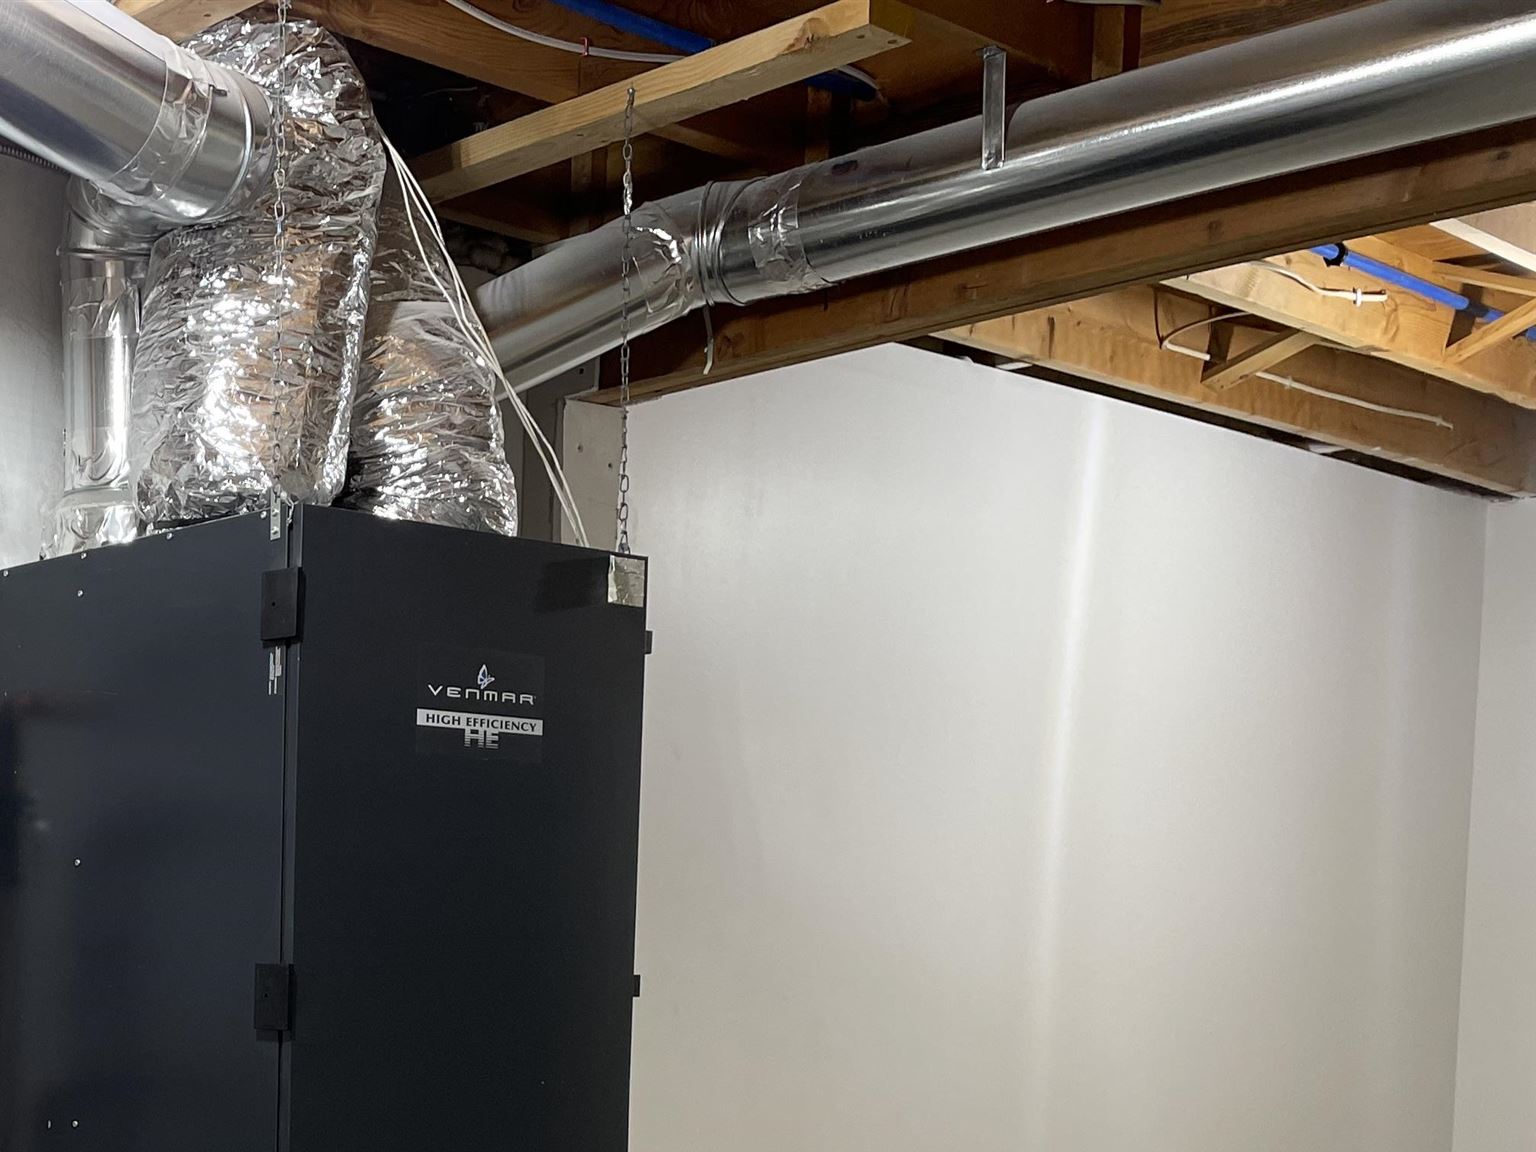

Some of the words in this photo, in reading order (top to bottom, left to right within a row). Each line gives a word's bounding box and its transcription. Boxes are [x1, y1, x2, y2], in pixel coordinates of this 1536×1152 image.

[427, 684, 535, 706] VENMAR
[425, 713, 461, 726] HIGH
[465, 716, 537, 732] EFFICIENCY
